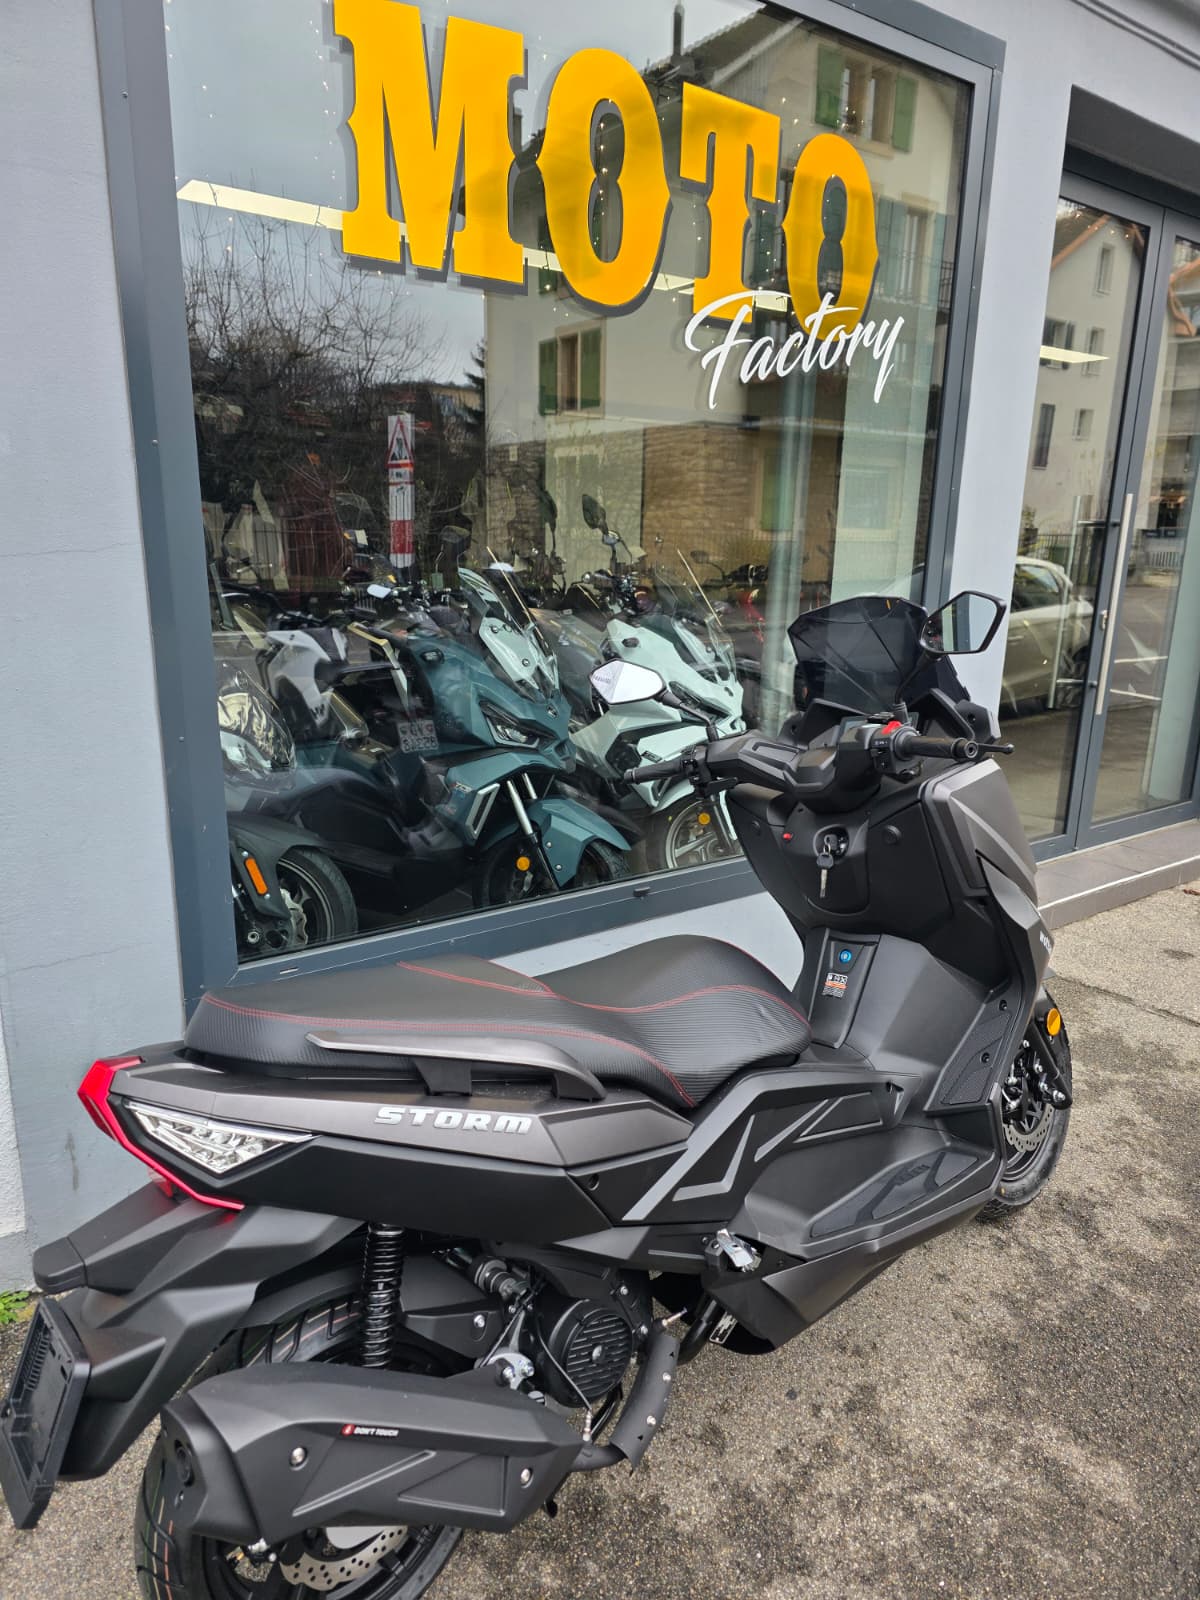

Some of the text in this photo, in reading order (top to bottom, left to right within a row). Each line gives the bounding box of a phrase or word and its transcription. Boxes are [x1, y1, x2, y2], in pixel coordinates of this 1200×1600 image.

[333, 0, 880, 341] MOTO
[685, 288, 905, 409] Factory
[374, 1106, 533, 1135] STORM
